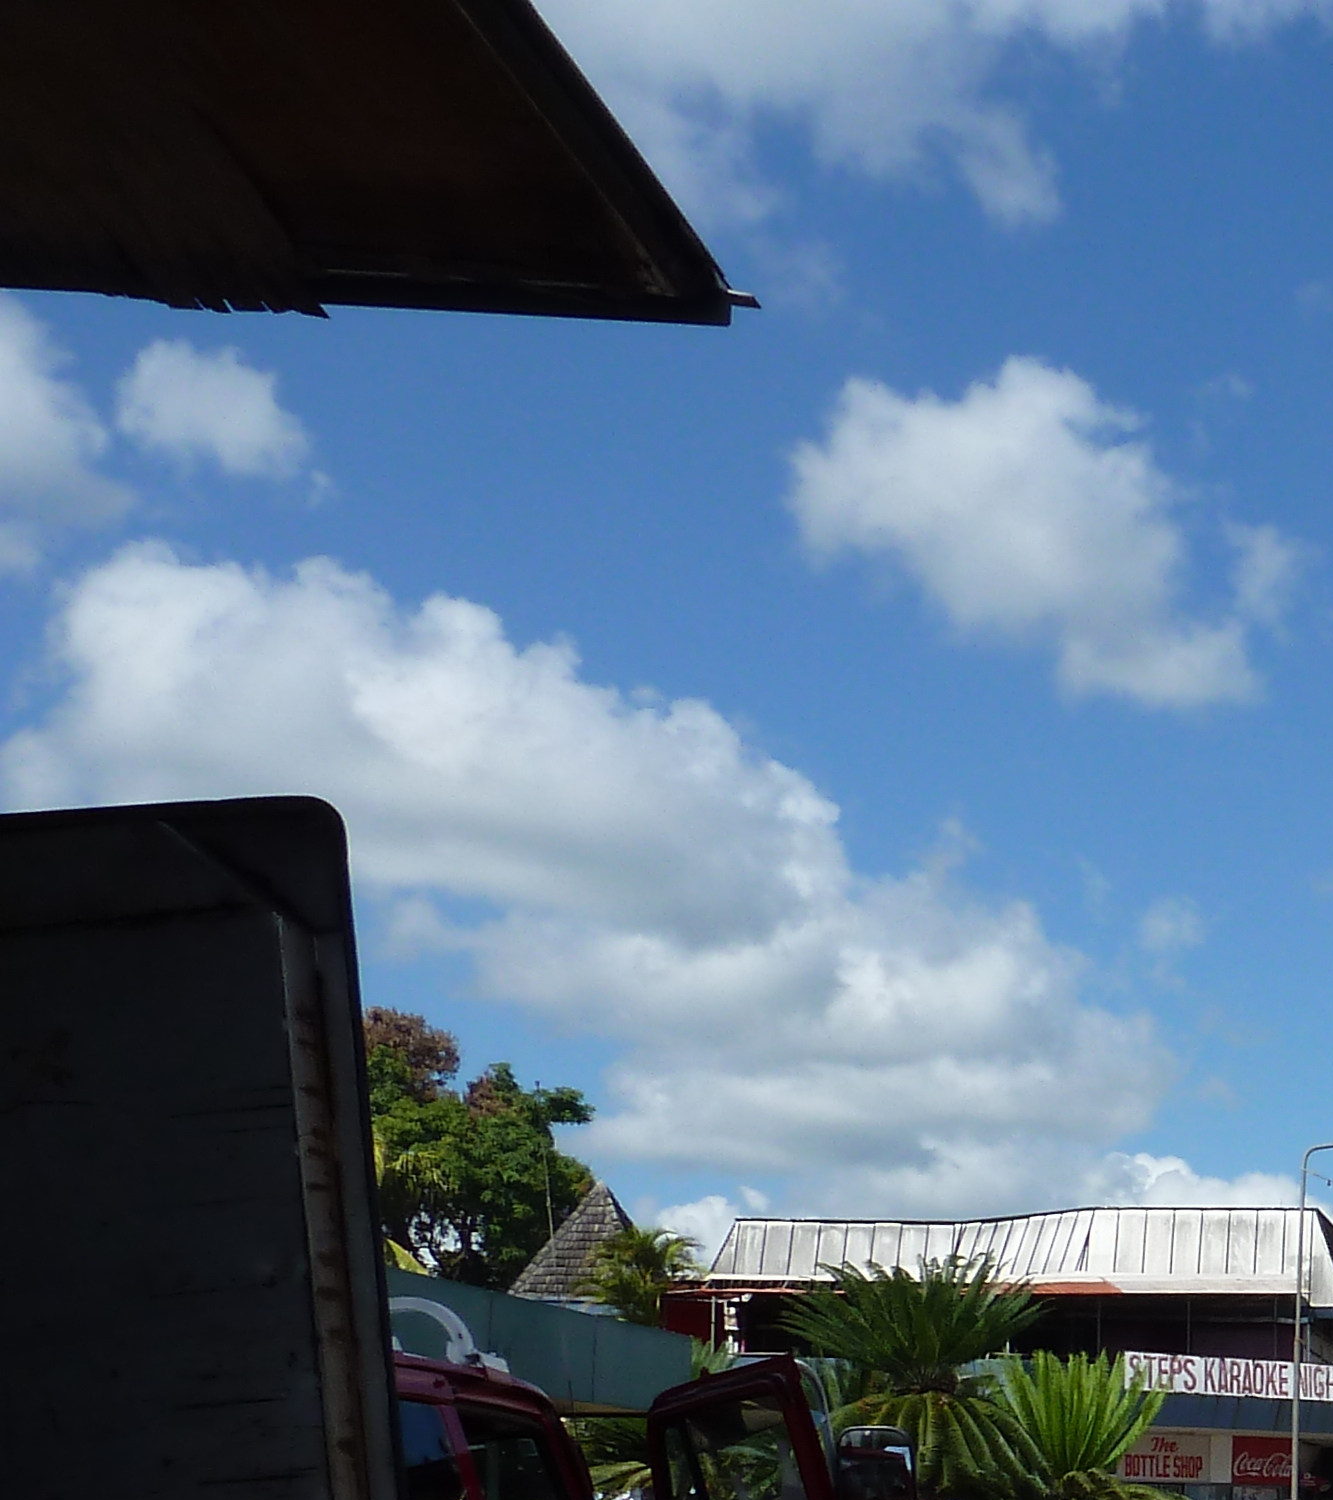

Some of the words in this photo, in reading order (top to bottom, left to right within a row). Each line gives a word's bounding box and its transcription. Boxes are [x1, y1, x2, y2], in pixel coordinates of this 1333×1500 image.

[1128, 1353, 1197, 1391] STEPS
[1204, 1357, 1289, 1396] KARAOKE
[1151, 1436, 1178, 1453] The
[1124, 1454, 1170, 1478] BOTTLE
[1173, 1455, 1204, 1479] SHOP
